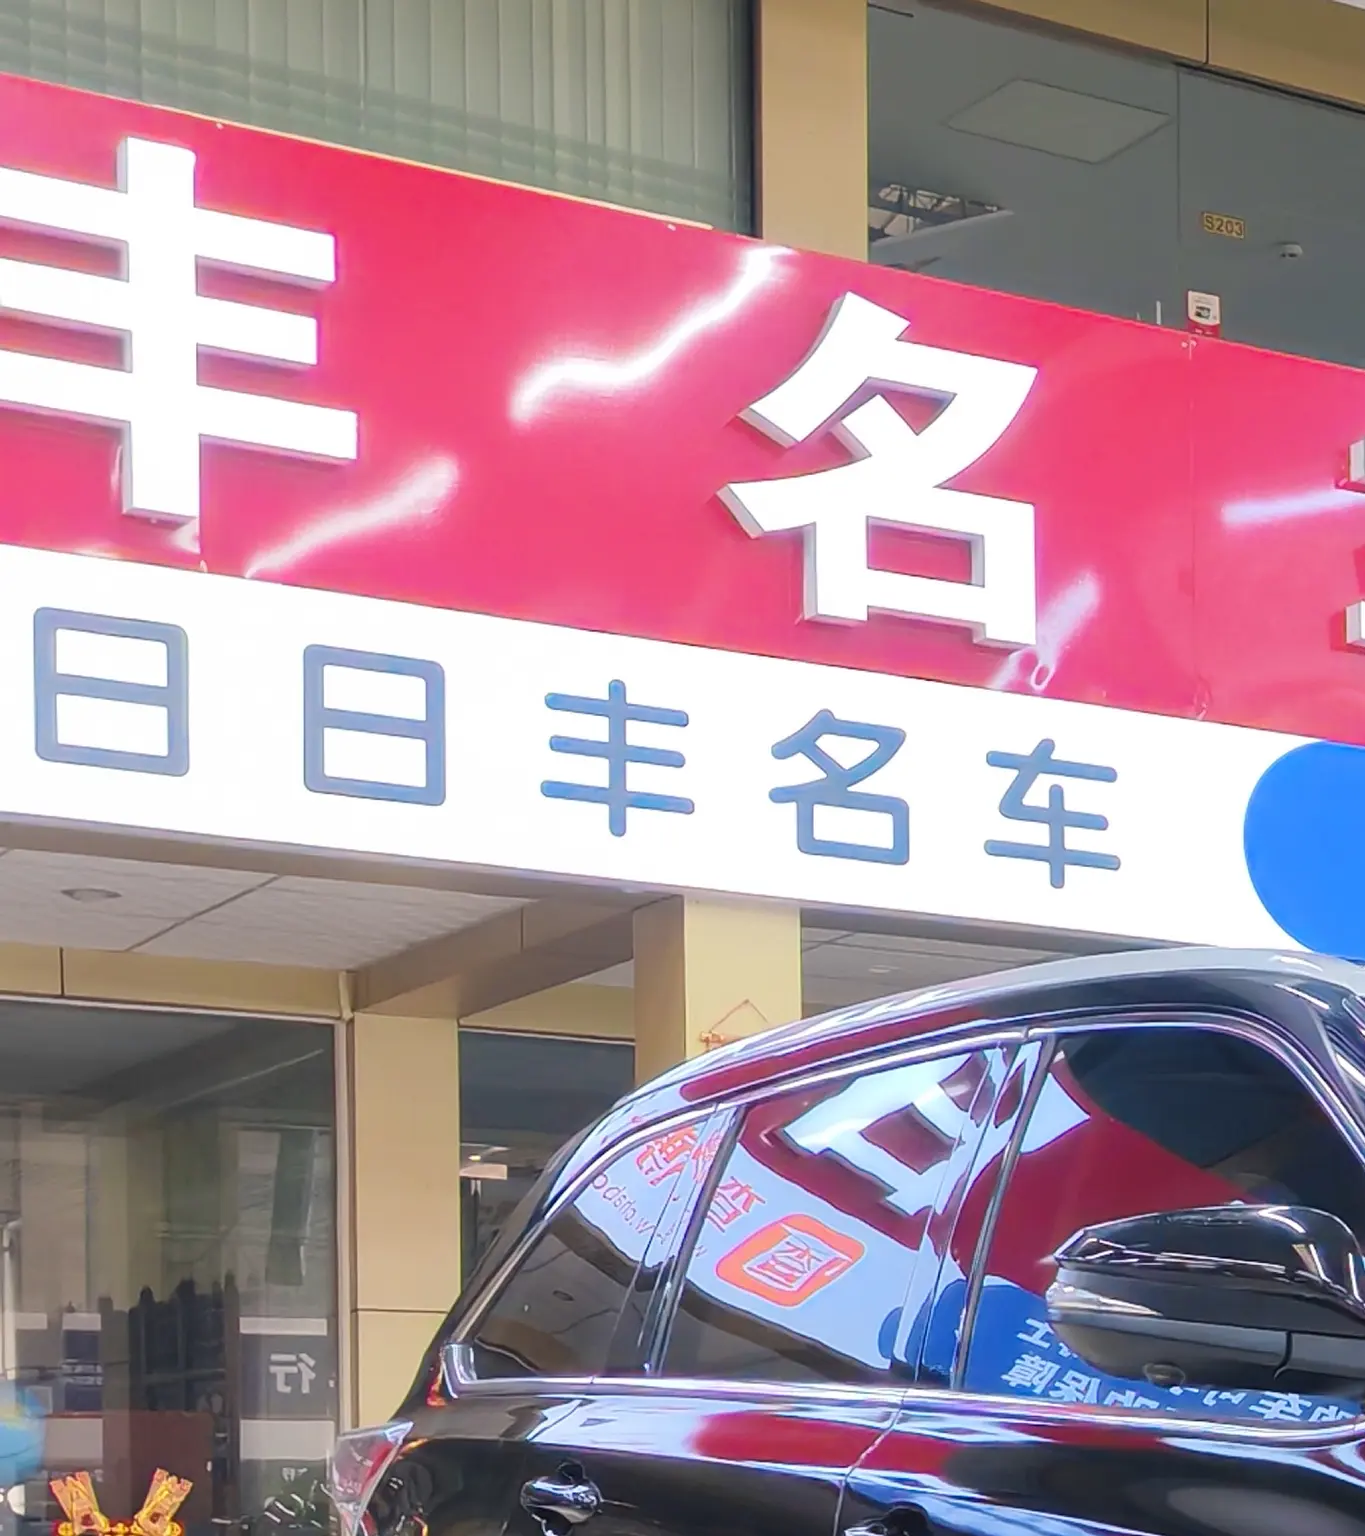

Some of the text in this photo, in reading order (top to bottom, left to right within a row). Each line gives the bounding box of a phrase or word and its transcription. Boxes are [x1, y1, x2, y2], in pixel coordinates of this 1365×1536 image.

[1205, 214, 1243, 237] S203
[33, 606, 1121, 888] 日日丰名车
